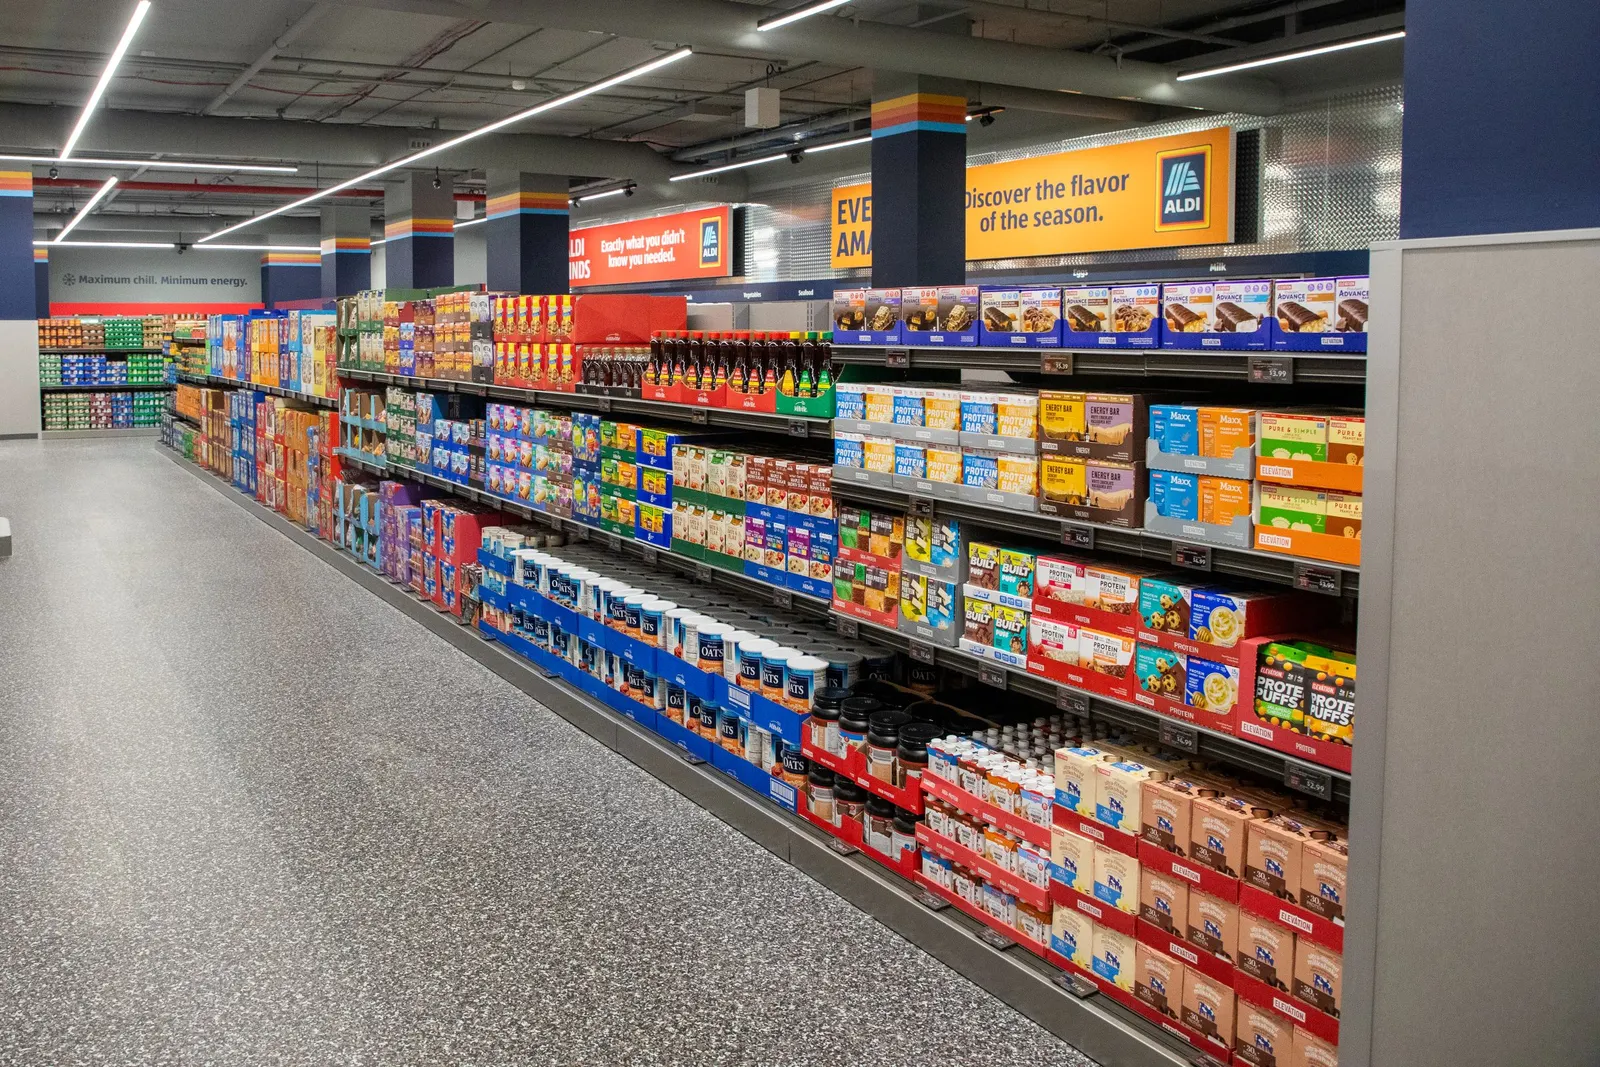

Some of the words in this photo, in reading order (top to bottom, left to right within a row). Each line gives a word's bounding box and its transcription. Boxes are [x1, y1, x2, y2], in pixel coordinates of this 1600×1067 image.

[1036, 179, 1065, 201] the
[1071, 173, 1130, 197] flavor
[1164, 197, 1200, 214] ALDI
[980, 210, 998, 232] of
[1000, 209, 1028, 230] the
[1034, 204, 1103, 227] season.
[601, 236, 624, 254] Exactly
[626, 234, 644, 250] what
[646, 235, 661, 251] you
[661, 228, 685, 245] didn't
[569, 238, 585, 257] LDI
[703, 247, 717, 257] ALDI
[608, 252, 627, 268] know
[629, 254, 642, 269] you
[644, 248, 675, 264] needed.
[1210, 262, 1226, 272] Milk
[1073, 269, 1089, 279] Eggs
[79, 275, 131, 285] Maximum
[134, 275, 157, 285] chill.
[161, 276, 208, 285] Minimum
[211, 277, 248, 288] energy.
[743, 291, 761, 299] Vegetables
[1216, 293, 1242, 301] ADVANCE
[836, 402, 863, 410] PROTEIN
[895, 406, 923, 416] PROTEIN
[1046, 403, 1062, 412] ENERGY
[1063, 405, 1072, 413] BAR
[1090, 406, 1110, 415] ENERGY
[1111, 407, 1120, 416] BAR
[927, 409, 956, 419] PROTEIN
[963, 414, 994, 424] PROTEIN
[1170, 411, 1191, 422] Maxx
[896, 415, 911, 425] BAR
[1000, 415, 1033, 426] PROTEIN
[1219, 414, 1242, 426] Maxx
[965, 422, 981, 433] BAR
[1294, 427, 1317, 435] SIMPLE
[1337, 429, 1355, 437] PURE
[836, 449, 862, 458] PROTEIN
[1076, 446, 1090, 454] ENERGY
[895, 456, 924, 467] PROTEIN
[897, 465, 912, 475] BAR
[965, 467, 997, 478] PROTEIN
[1047, 465, 1063, 474] ENERGY
[1064, 467, 1074, 475] BAR
[1261, 465, 1292, 477] ELEVATION
[967, 475, 983, 486] BAR
[1000, 471, 1033, 482] PROTEIN
[1091, 471, 1110, 480] ENERGY
[1111, 472, 1121, 481] BAR
[1170, 474, 1191, 487] Maxx
[1219, 481, 1242, 494] Maxx
[1268, 493, 1285, 501] PURE
[1294, 496, 1317, 505] SIMPLE
[1334, 502, 1352, 510] PURE
[1260, 534, 1290, 546] ELEVATION
[970, 556, 997, 570] BUILT
[1001, 562, 1030, 577] BUILT
[1049, 569, 1072, 579] PROTEIN
[1100, 580, 1126, 590] PROTEIN
[965, 610, 991, 624] BUILT
[995, 618, 1023, 633] BUILT
[1041, 628, 1064, 639] PROTEIN
[701, 646, 723, 658] OATS
[1093, 641, 1118, 652] PROTEIN
[1173, 641, 1199, 654] PROTEIN
[1256, 687, 1299, 709] PUFFS
[1169, 706, 1194, 719] PROTEIN
[1310, 703, 1350, 725] PUFFS
[1243, 722, 1272, 739] ELEVATION
[1295, 742, 1317, 755] PROTEIN
[783, 757, 804, 771] OATS
[1081, 824, 1103, 839] ELEVATION
[1173, 864, 1200, 881] ELEVATION
[1078, 900, 1101, 917] ELEVATION
[1281, 911, 1312, 930] ELEVATION
[1171, 944, 1198, 963] ELEVATION
[1274, 999, 1305, 1021] ELEVATION
